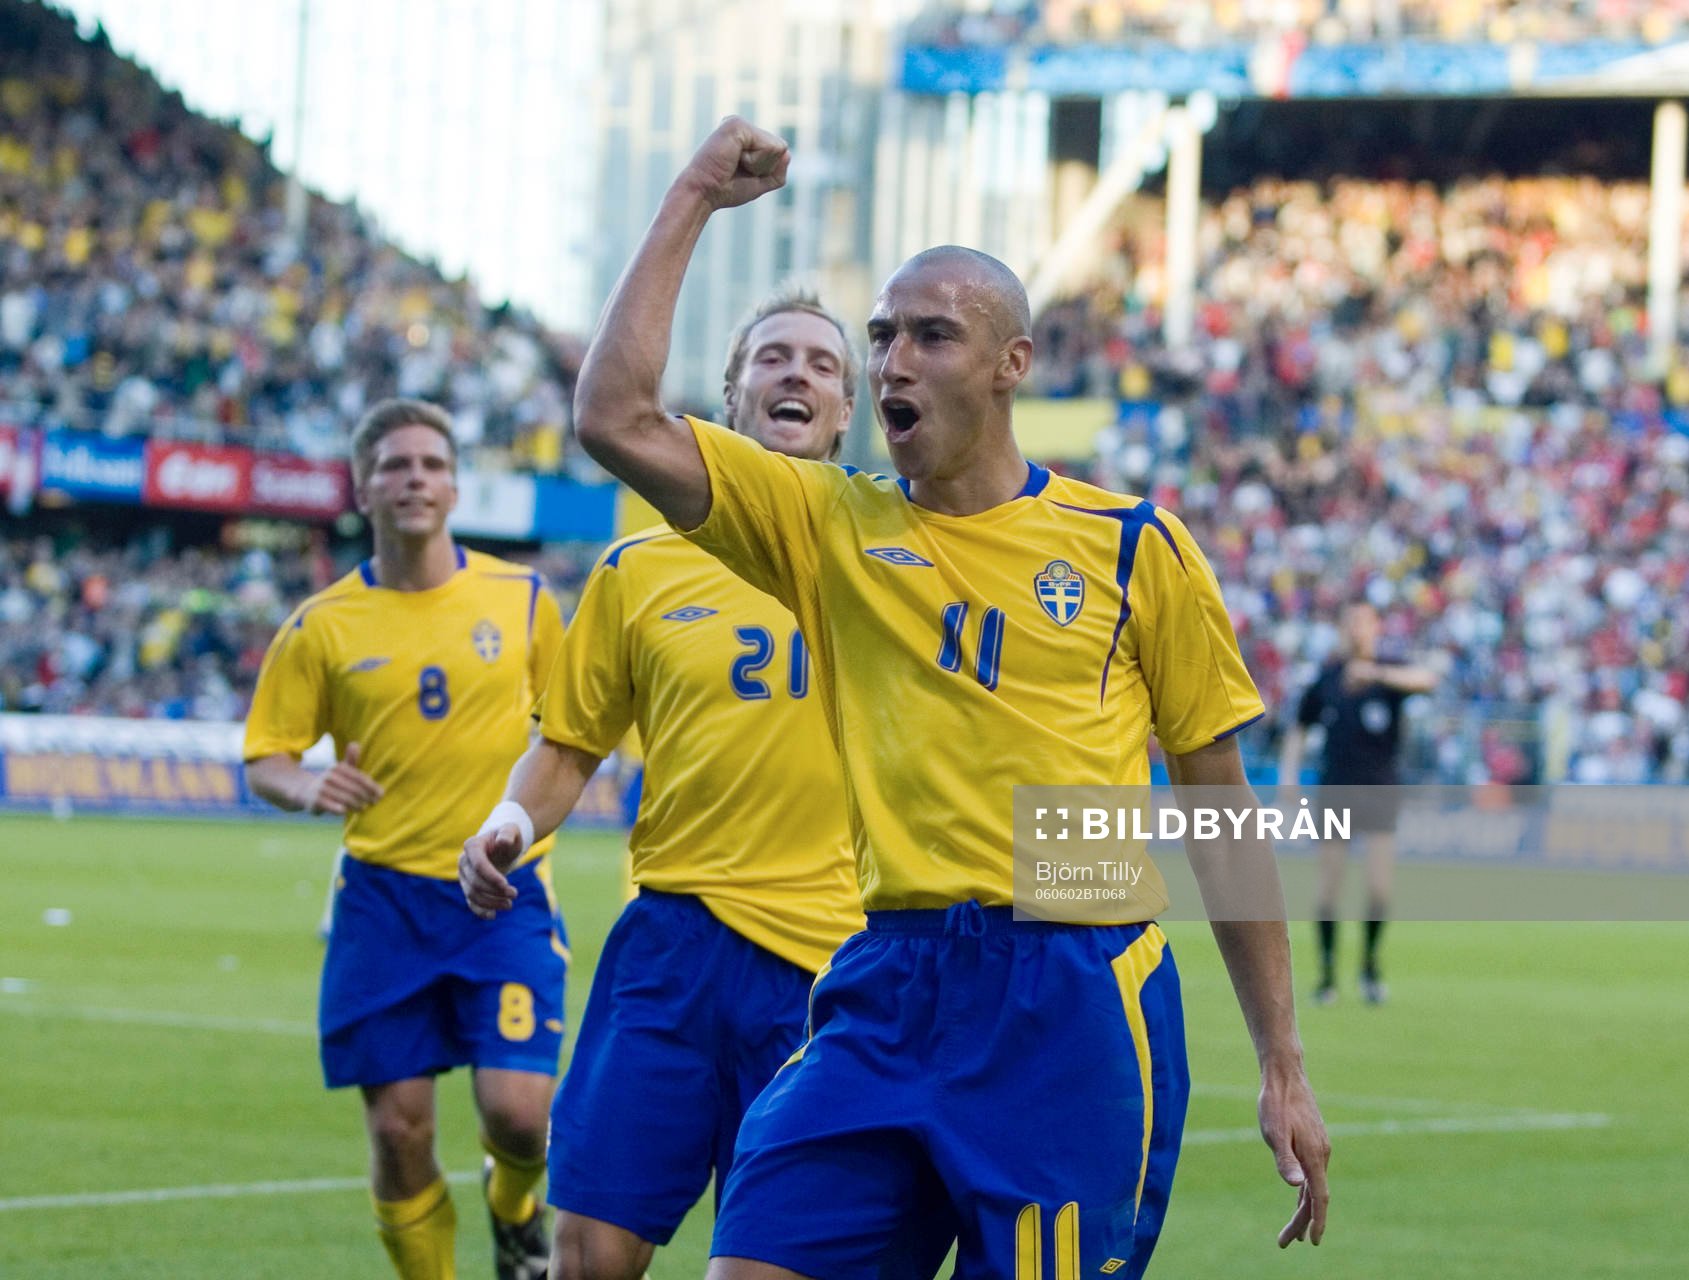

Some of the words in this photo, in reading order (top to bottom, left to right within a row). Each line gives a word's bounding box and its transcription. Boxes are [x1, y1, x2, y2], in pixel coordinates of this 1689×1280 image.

[729, 625, 809, 700] 21
[936, 601, 1005, 691] 11
[418, 665, 450, 721] 8
[498, 982, 536, 1041] 8
[1015, 1201, 1080, 1280] 11
